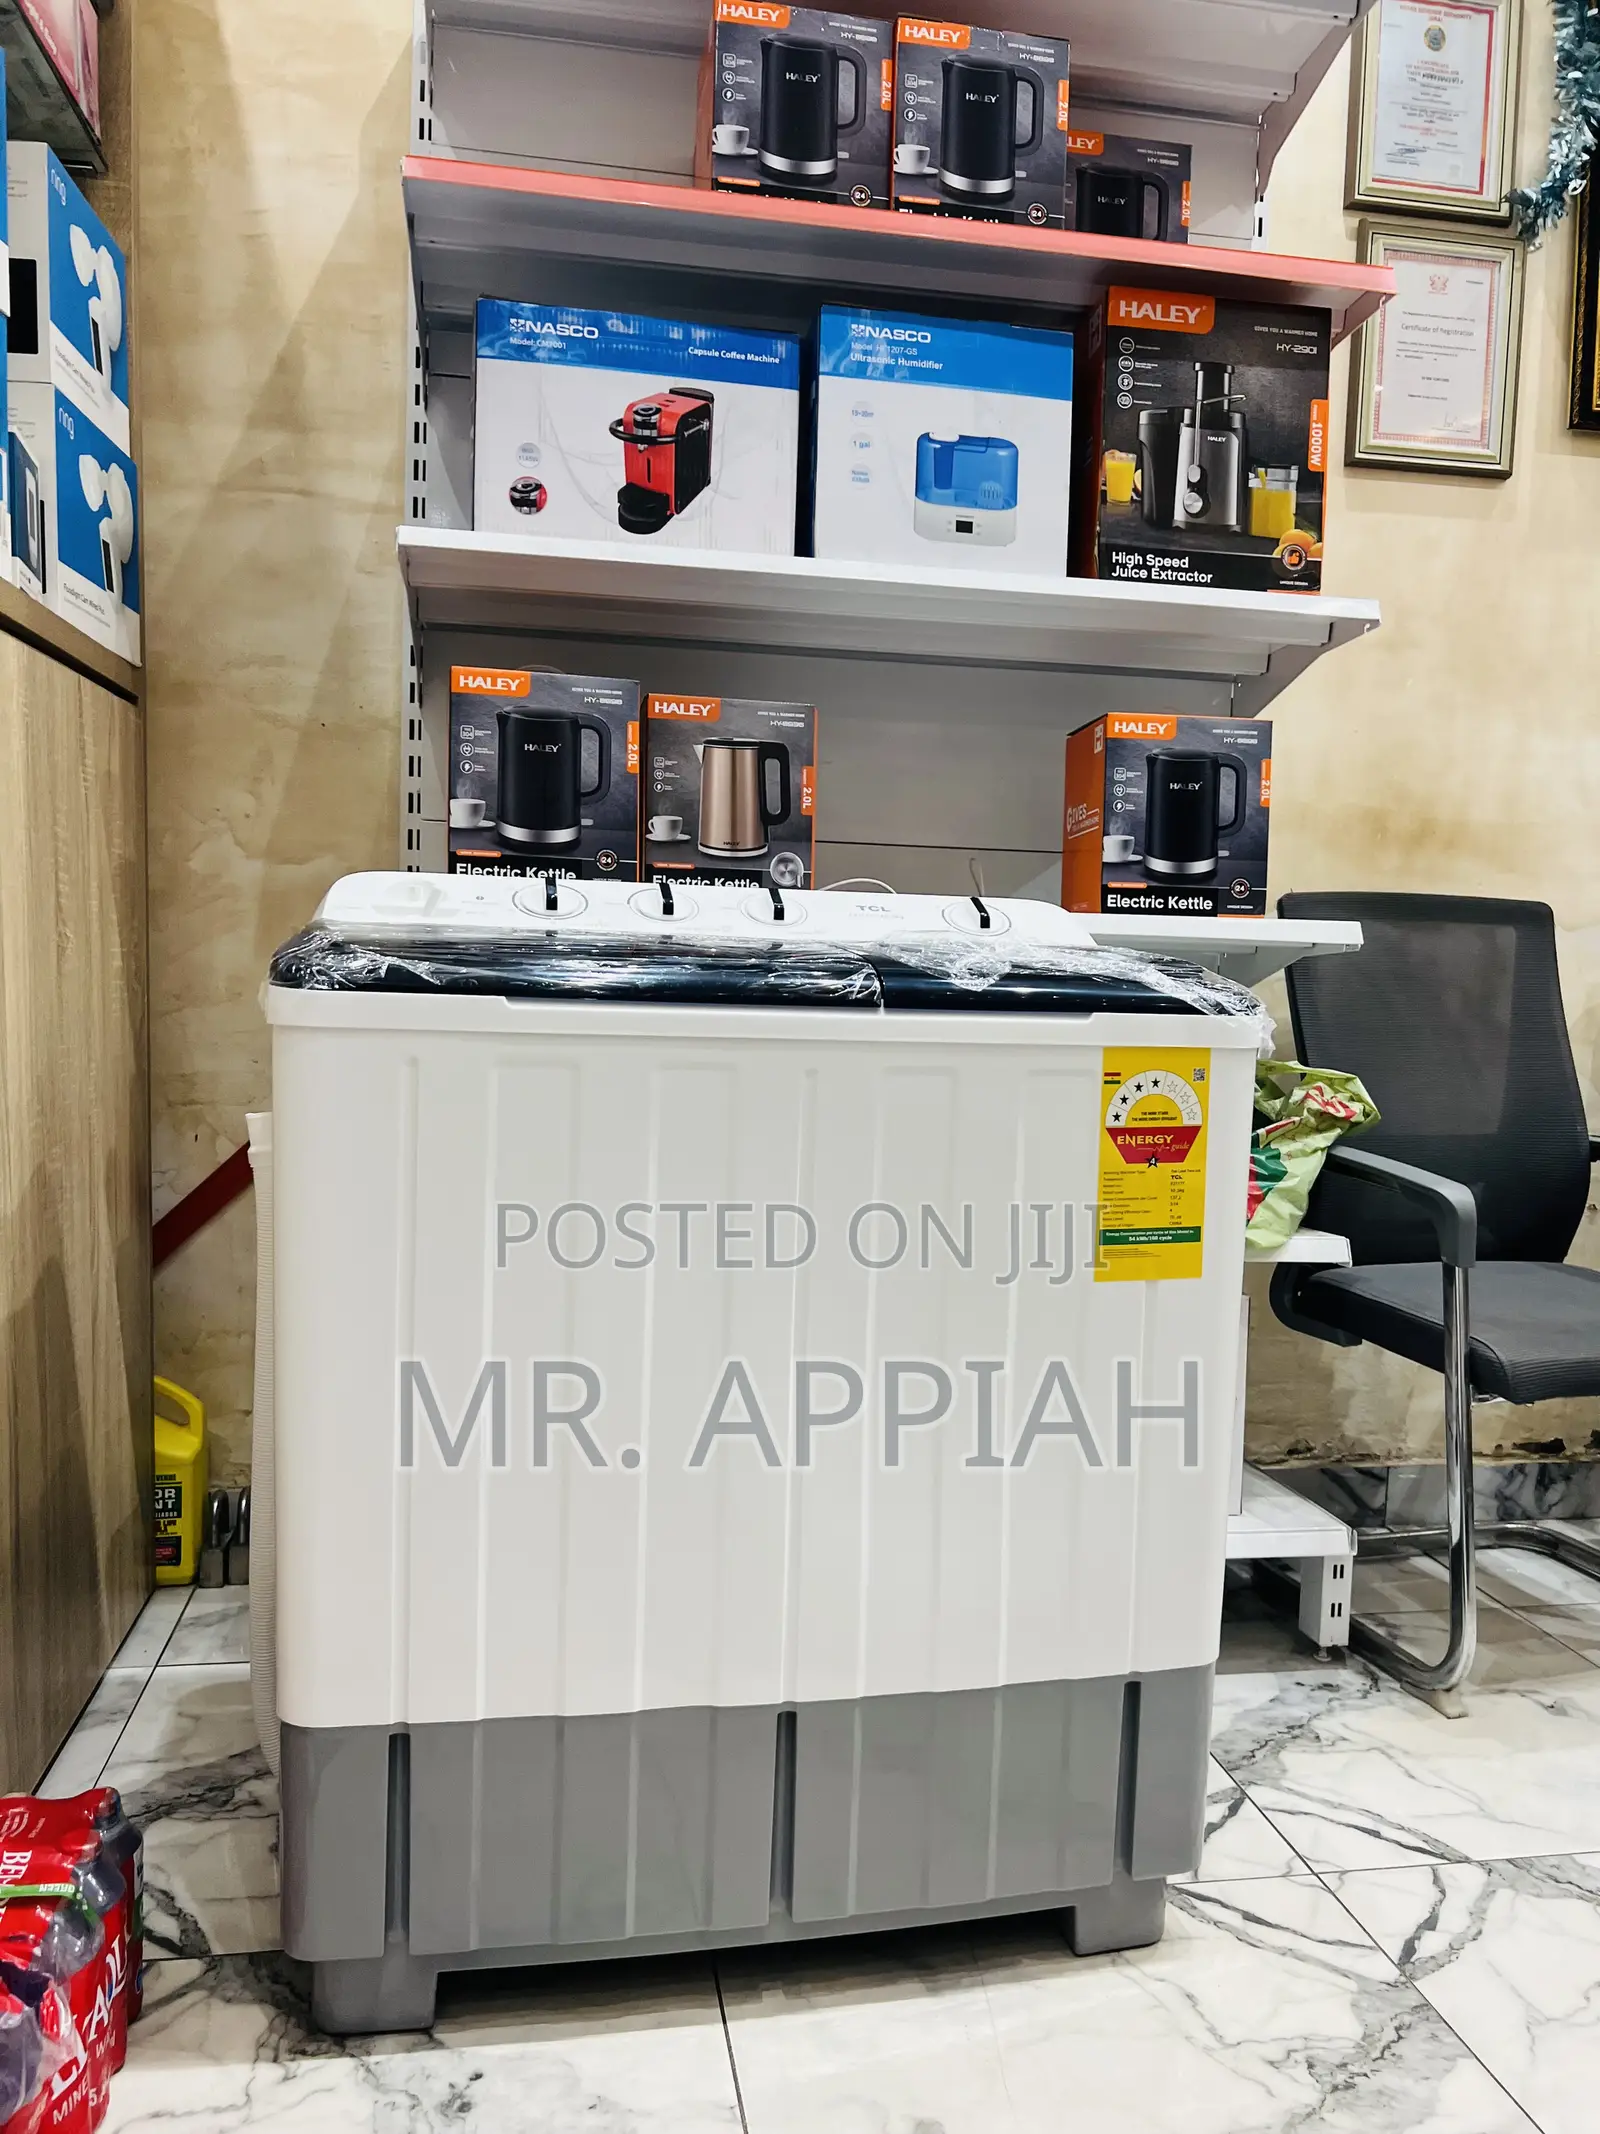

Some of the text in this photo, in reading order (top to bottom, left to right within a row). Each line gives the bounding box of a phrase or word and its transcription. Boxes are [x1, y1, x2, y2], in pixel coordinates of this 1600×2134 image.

[721, 4, 780, 21] HALEY
[905, 25, 960, 43] HALEY
[881, 80, 892, 104] 2.0L
[1058, 101, 1068, 124] 2.0L
[1067, 136, 1096, 149] LEY
[1097, 196, 1126, 205] HAEY
[1182, 200, 1190, 220] 2.0L
[1119, 300, 1200, 324] HALEY
[526, 320, 599, 339] NASCO
[865, 326, 931, 344] NASCO
[688, 346, 780, 364] Capsule Coffee Machine
[850, 352, 943, 370] Ultrasonic Humidifier
[58, 406, 74, 440] ring
[1207, 435, 1227, 443] HALEY
[1310, 422, 1323, 467] 1000W
[1112, 551, 1189, 570] High Speed
[1111, 565, 1213, 584] Juice Extractor
[459, 675, 521, 691] HALEY
[654, 701, 711, 716] HALEY
[1114, 721, 1167, 735] HALEY
[524, 743, 558, 753] HALEY
[627, 743, 638, 767] 2.0L
[1169, 782, 1201, 791] HALEY
[1261, 779, 1270, 802] 2.0L
[802, 787, 812, 809] 2.0L
[601, 855, 611, 864] 24
[456, 863, 577, 880] Electric Kettle
[1234, 884, 1245, 892] 24
[1106, 894, 1213, 911] Electric Kettle
[1117, 1133, 1174, 1147] ENERGY
[1150, 1157, 1156, 1165] 4
